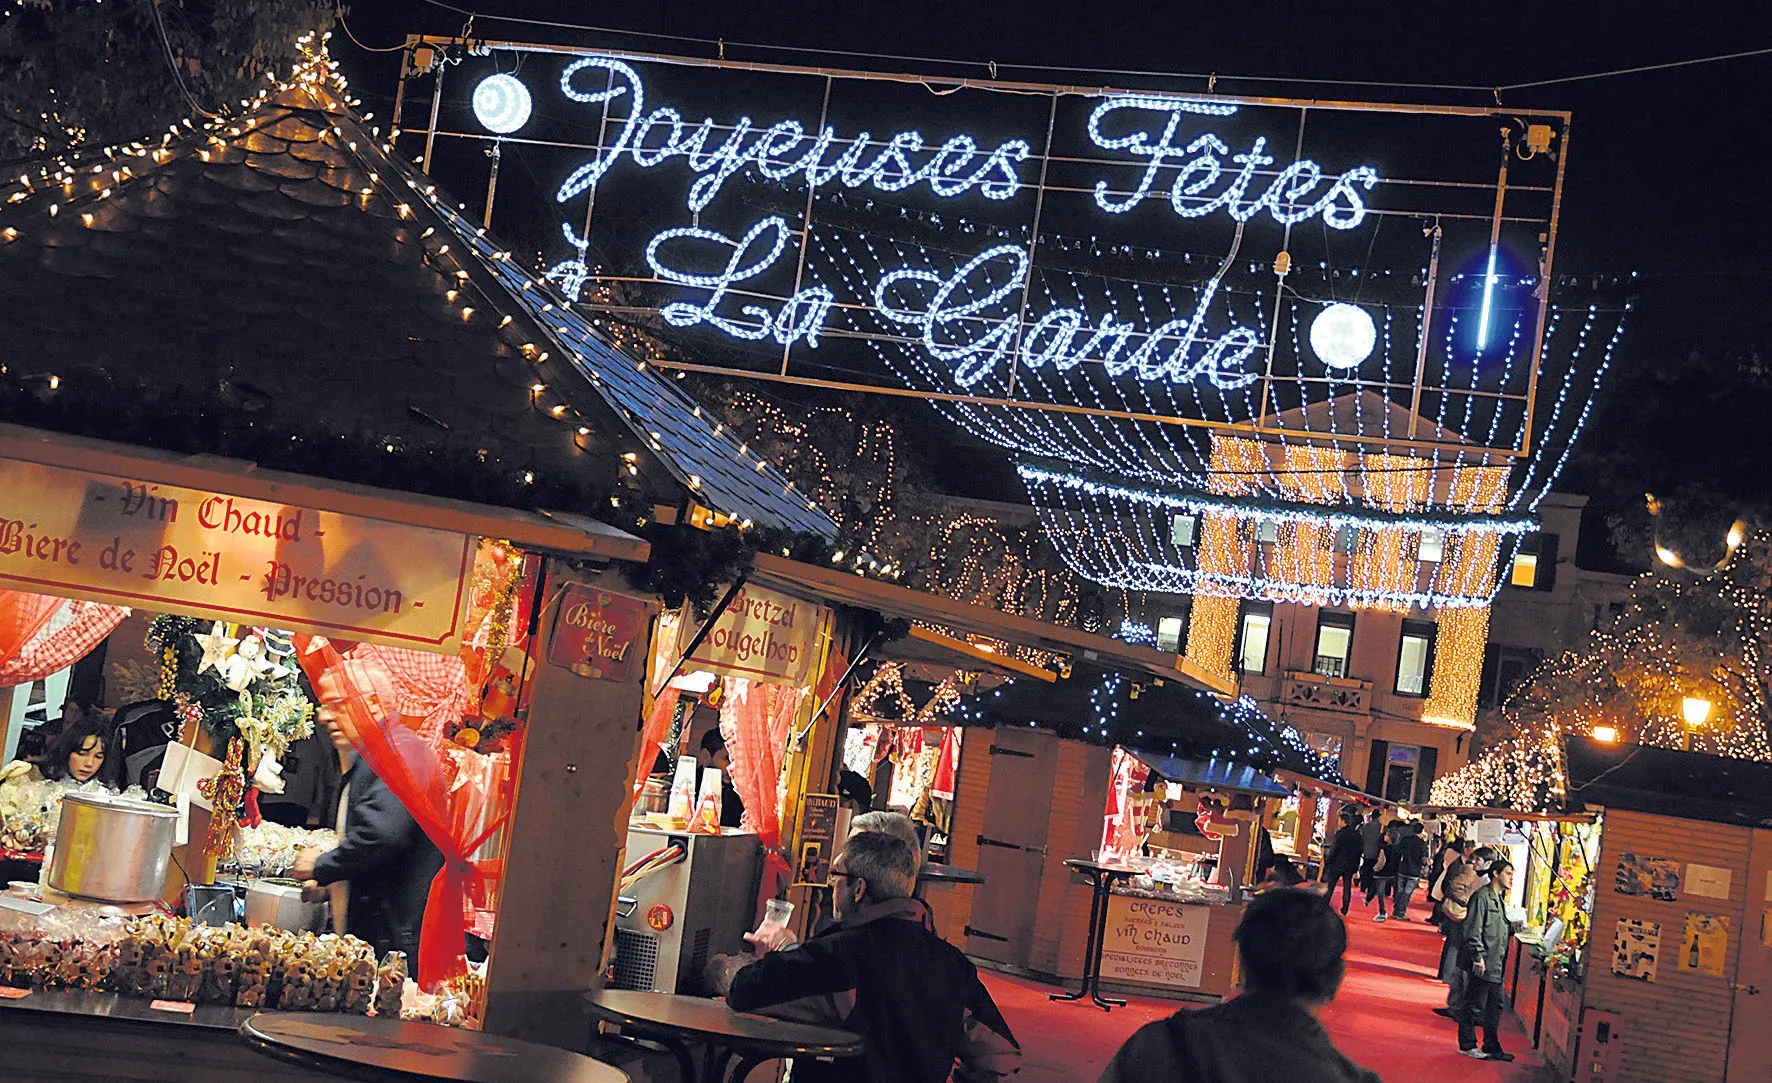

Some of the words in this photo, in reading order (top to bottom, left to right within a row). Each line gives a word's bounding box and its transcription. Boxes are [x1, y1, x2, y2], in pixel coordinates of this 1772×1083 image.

[556, 57, 1029, 211] Joyeuses
[1088, 96, 1377, 229] Fêtes
[645, 215, 833, 348] La
[874, 244, 1258, 390] Garde
[120, 481, 179, 523] Vin
[198, 496, 302, 543] Chaud
[100, 536, 135, 573] de
[142, 544, 220, 586] Noël
[260, 561, 402, 613] Pression
[566, 602, 616, 635] Bière
[726, 587, 796, 628] Bretzel
[582, 635, 630, 661] Noël
[585, 632, 595, 643] de
